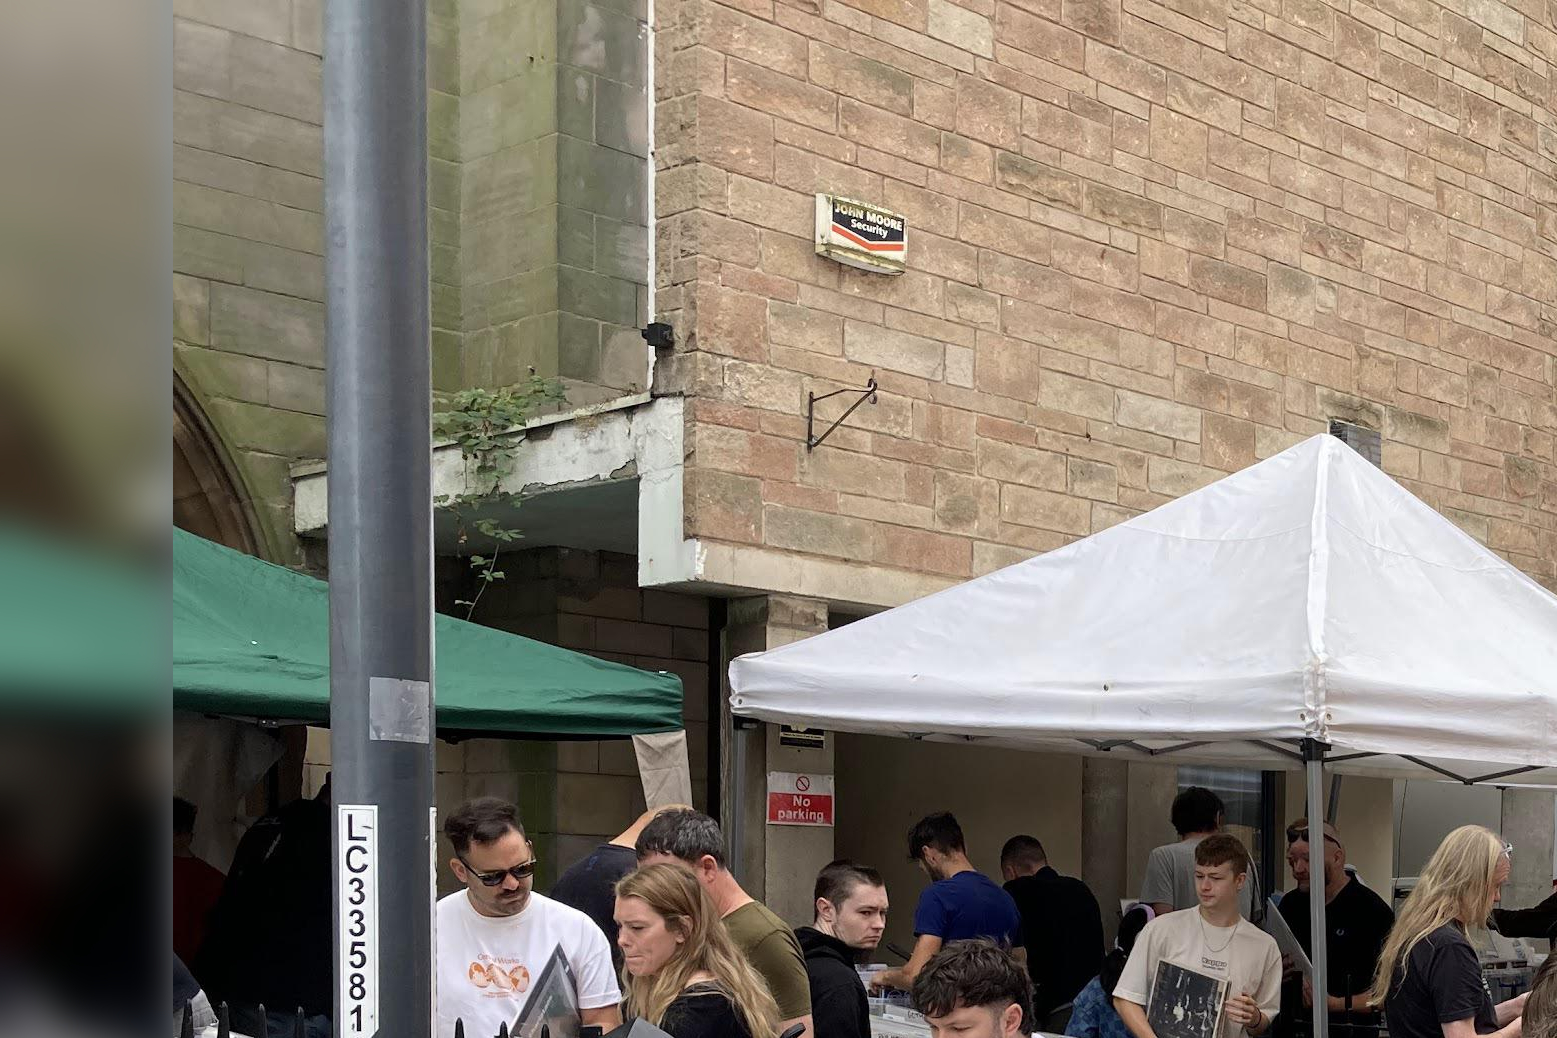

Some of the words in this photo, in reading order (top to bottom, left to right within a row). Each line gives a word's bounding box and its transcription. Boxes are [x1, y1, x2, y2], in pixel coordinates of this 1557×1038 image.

[834, 204, 864, 220] JOHN
[866, 211, 903, 231] MOORE
[850, 218, 888, 239] Security
[792, 795, 811, 807] No
[777, 808, 824, 823] parking
[345, 813, 369, 1032] LC33581
